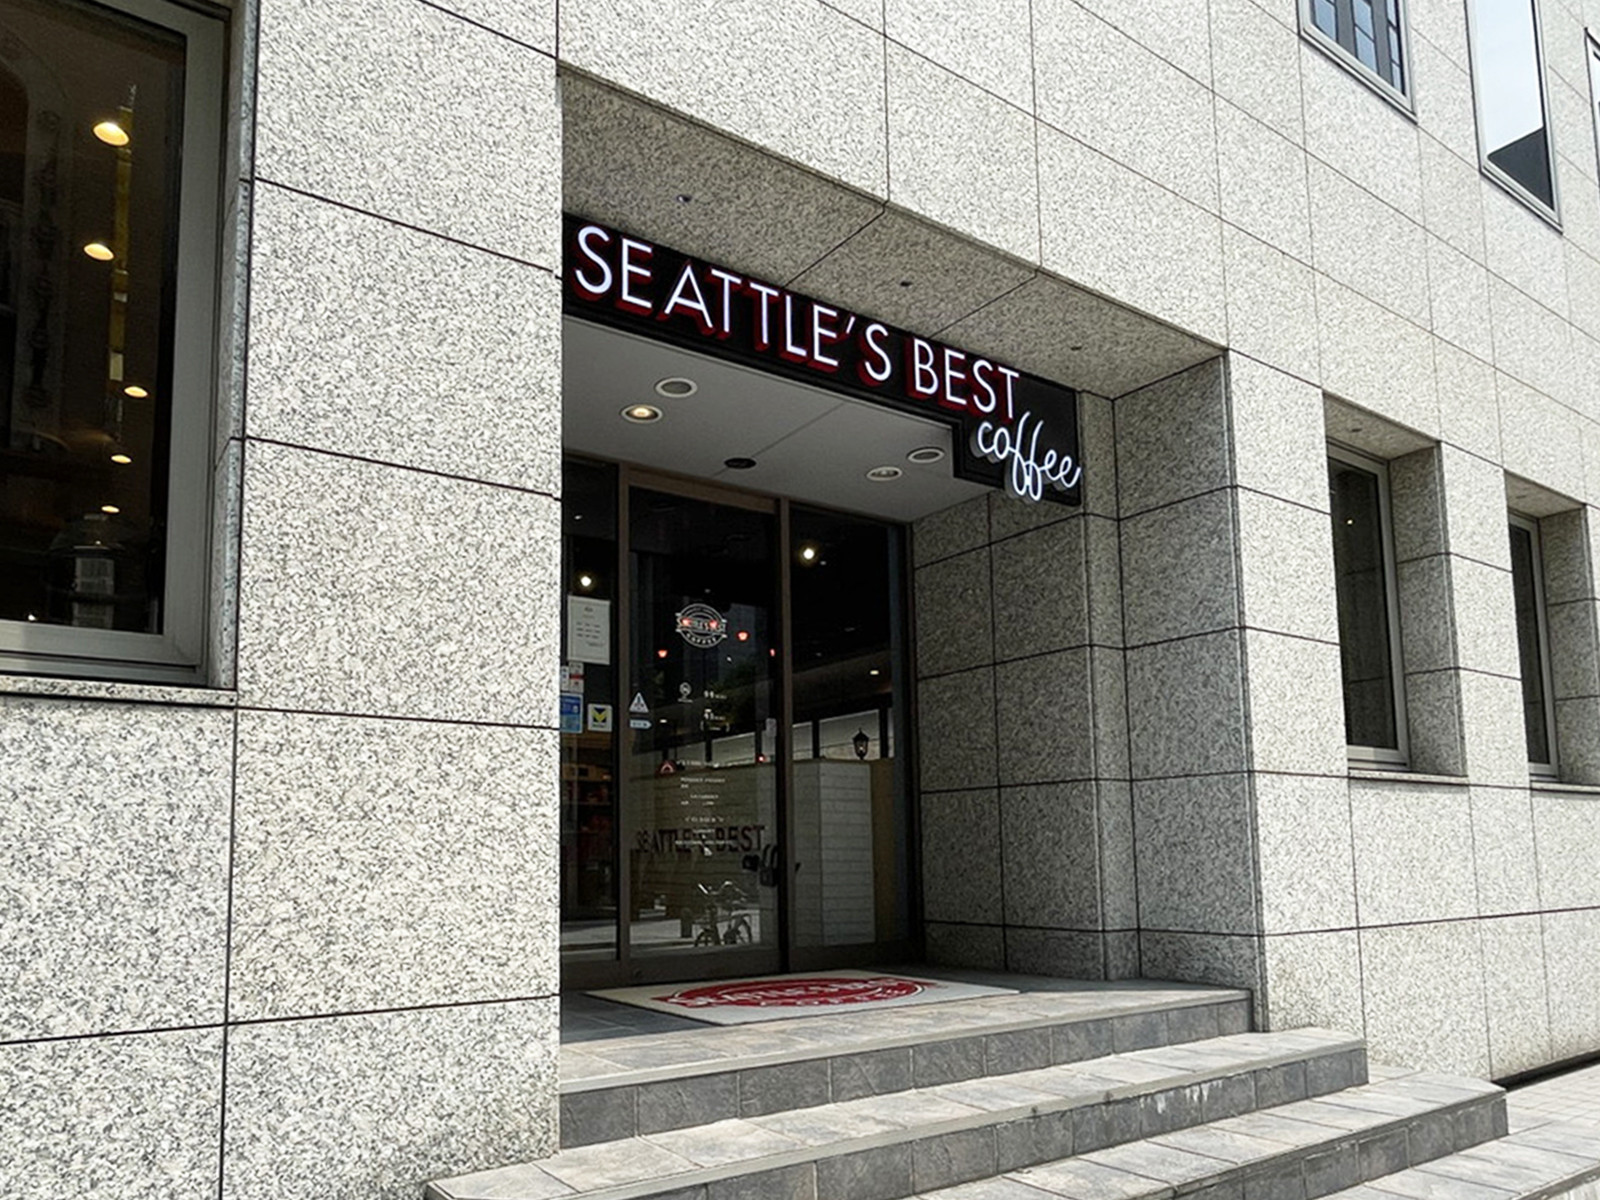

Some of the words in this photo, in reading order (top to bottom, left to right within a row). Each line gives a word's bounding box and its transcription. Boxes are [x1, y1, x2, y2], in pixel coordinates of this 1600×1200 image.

[574, 224, 894, 383] SEATTLE'S
[913, 338, 1020, 419] BEST
[976, 410, 1082, 502] coffee
